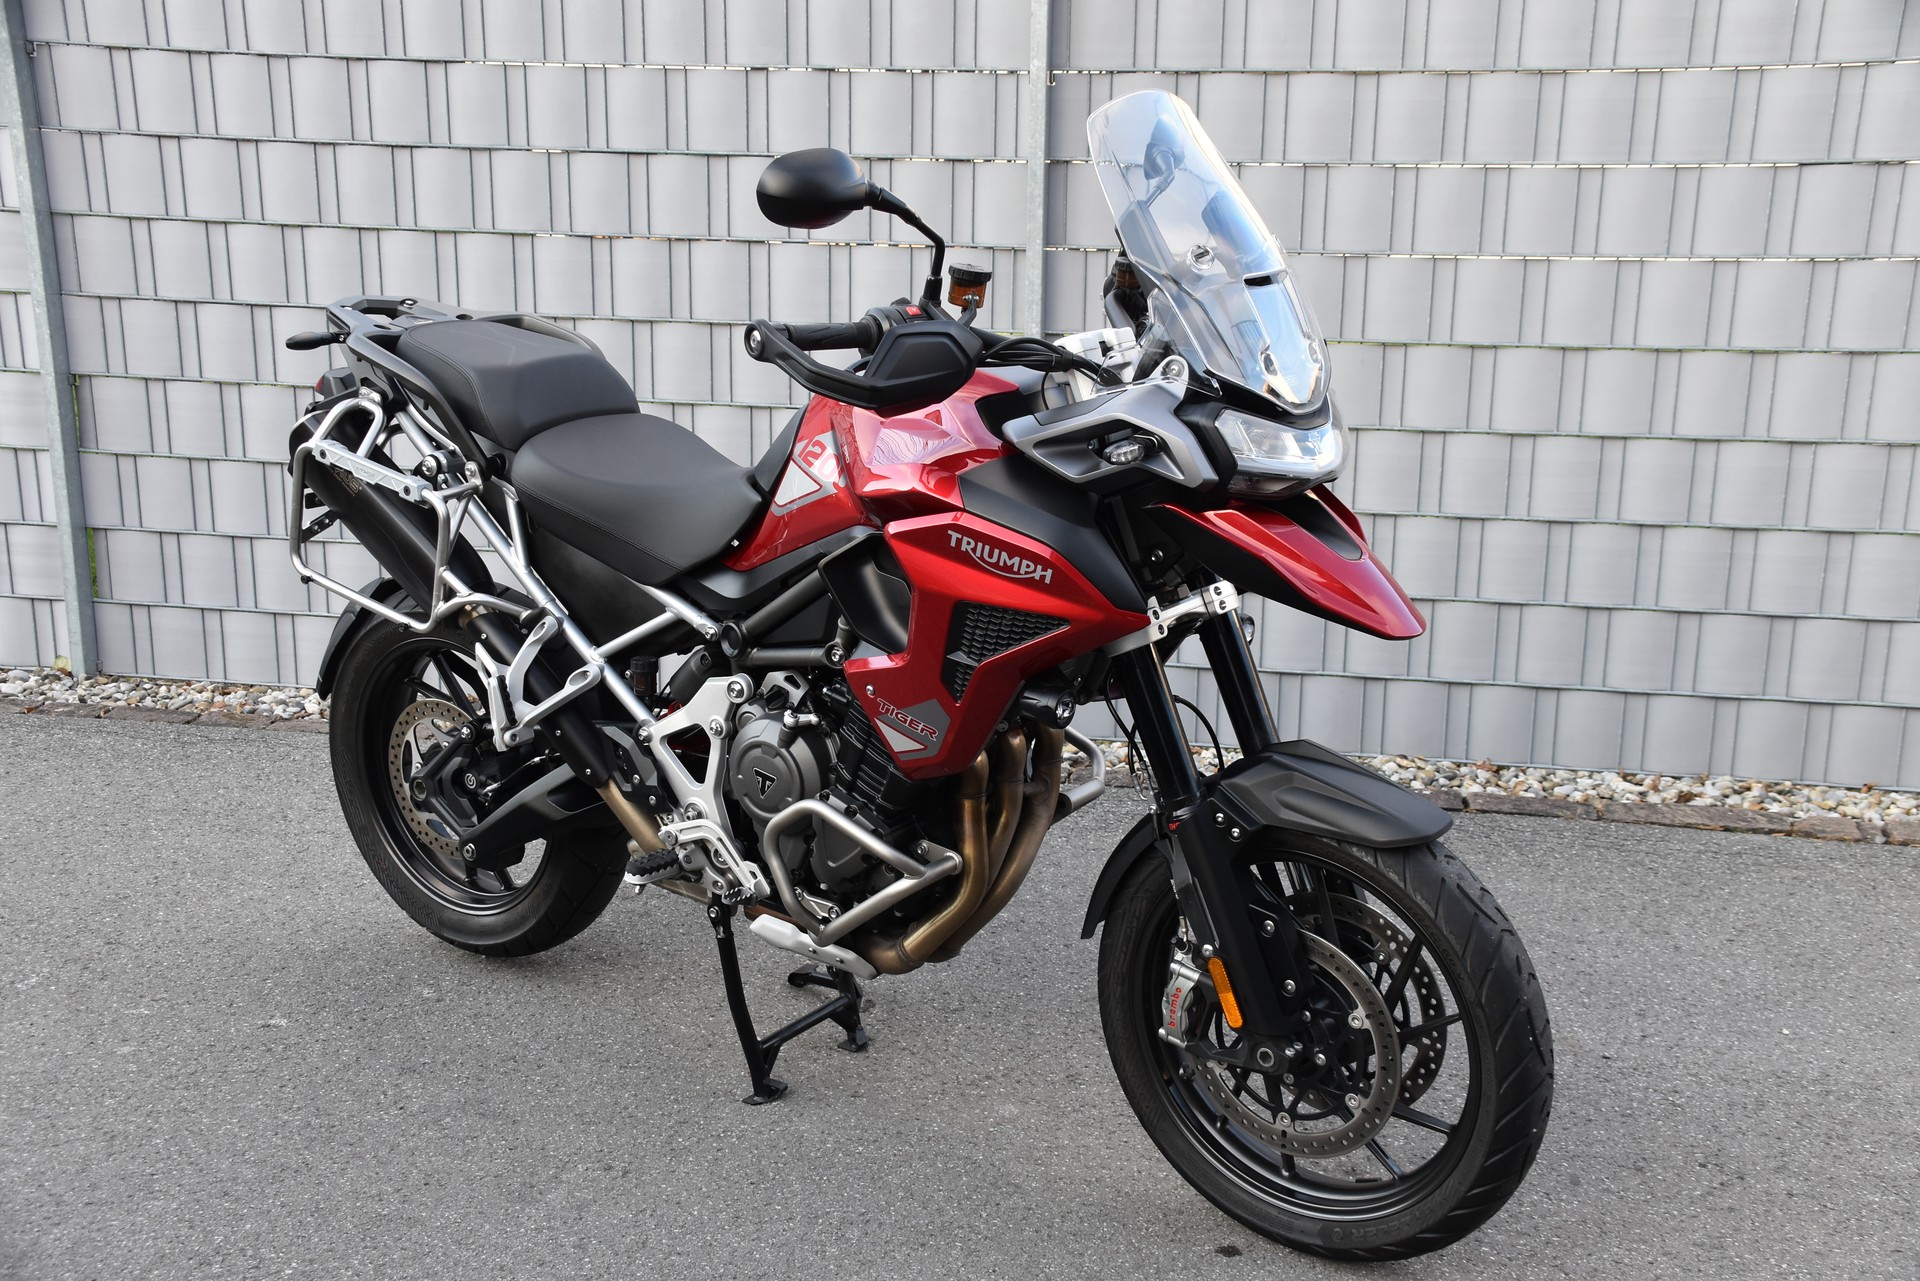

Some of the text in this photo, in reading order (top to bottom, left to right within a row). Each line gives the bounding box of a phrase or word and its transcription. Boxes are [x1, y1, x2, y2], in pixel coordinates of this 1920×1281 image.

[948, 530, 1053, 584] TRIUMPH
[877, 698, 939, 741] TIGER
[1168, 987, 1182, 1027] brembo
